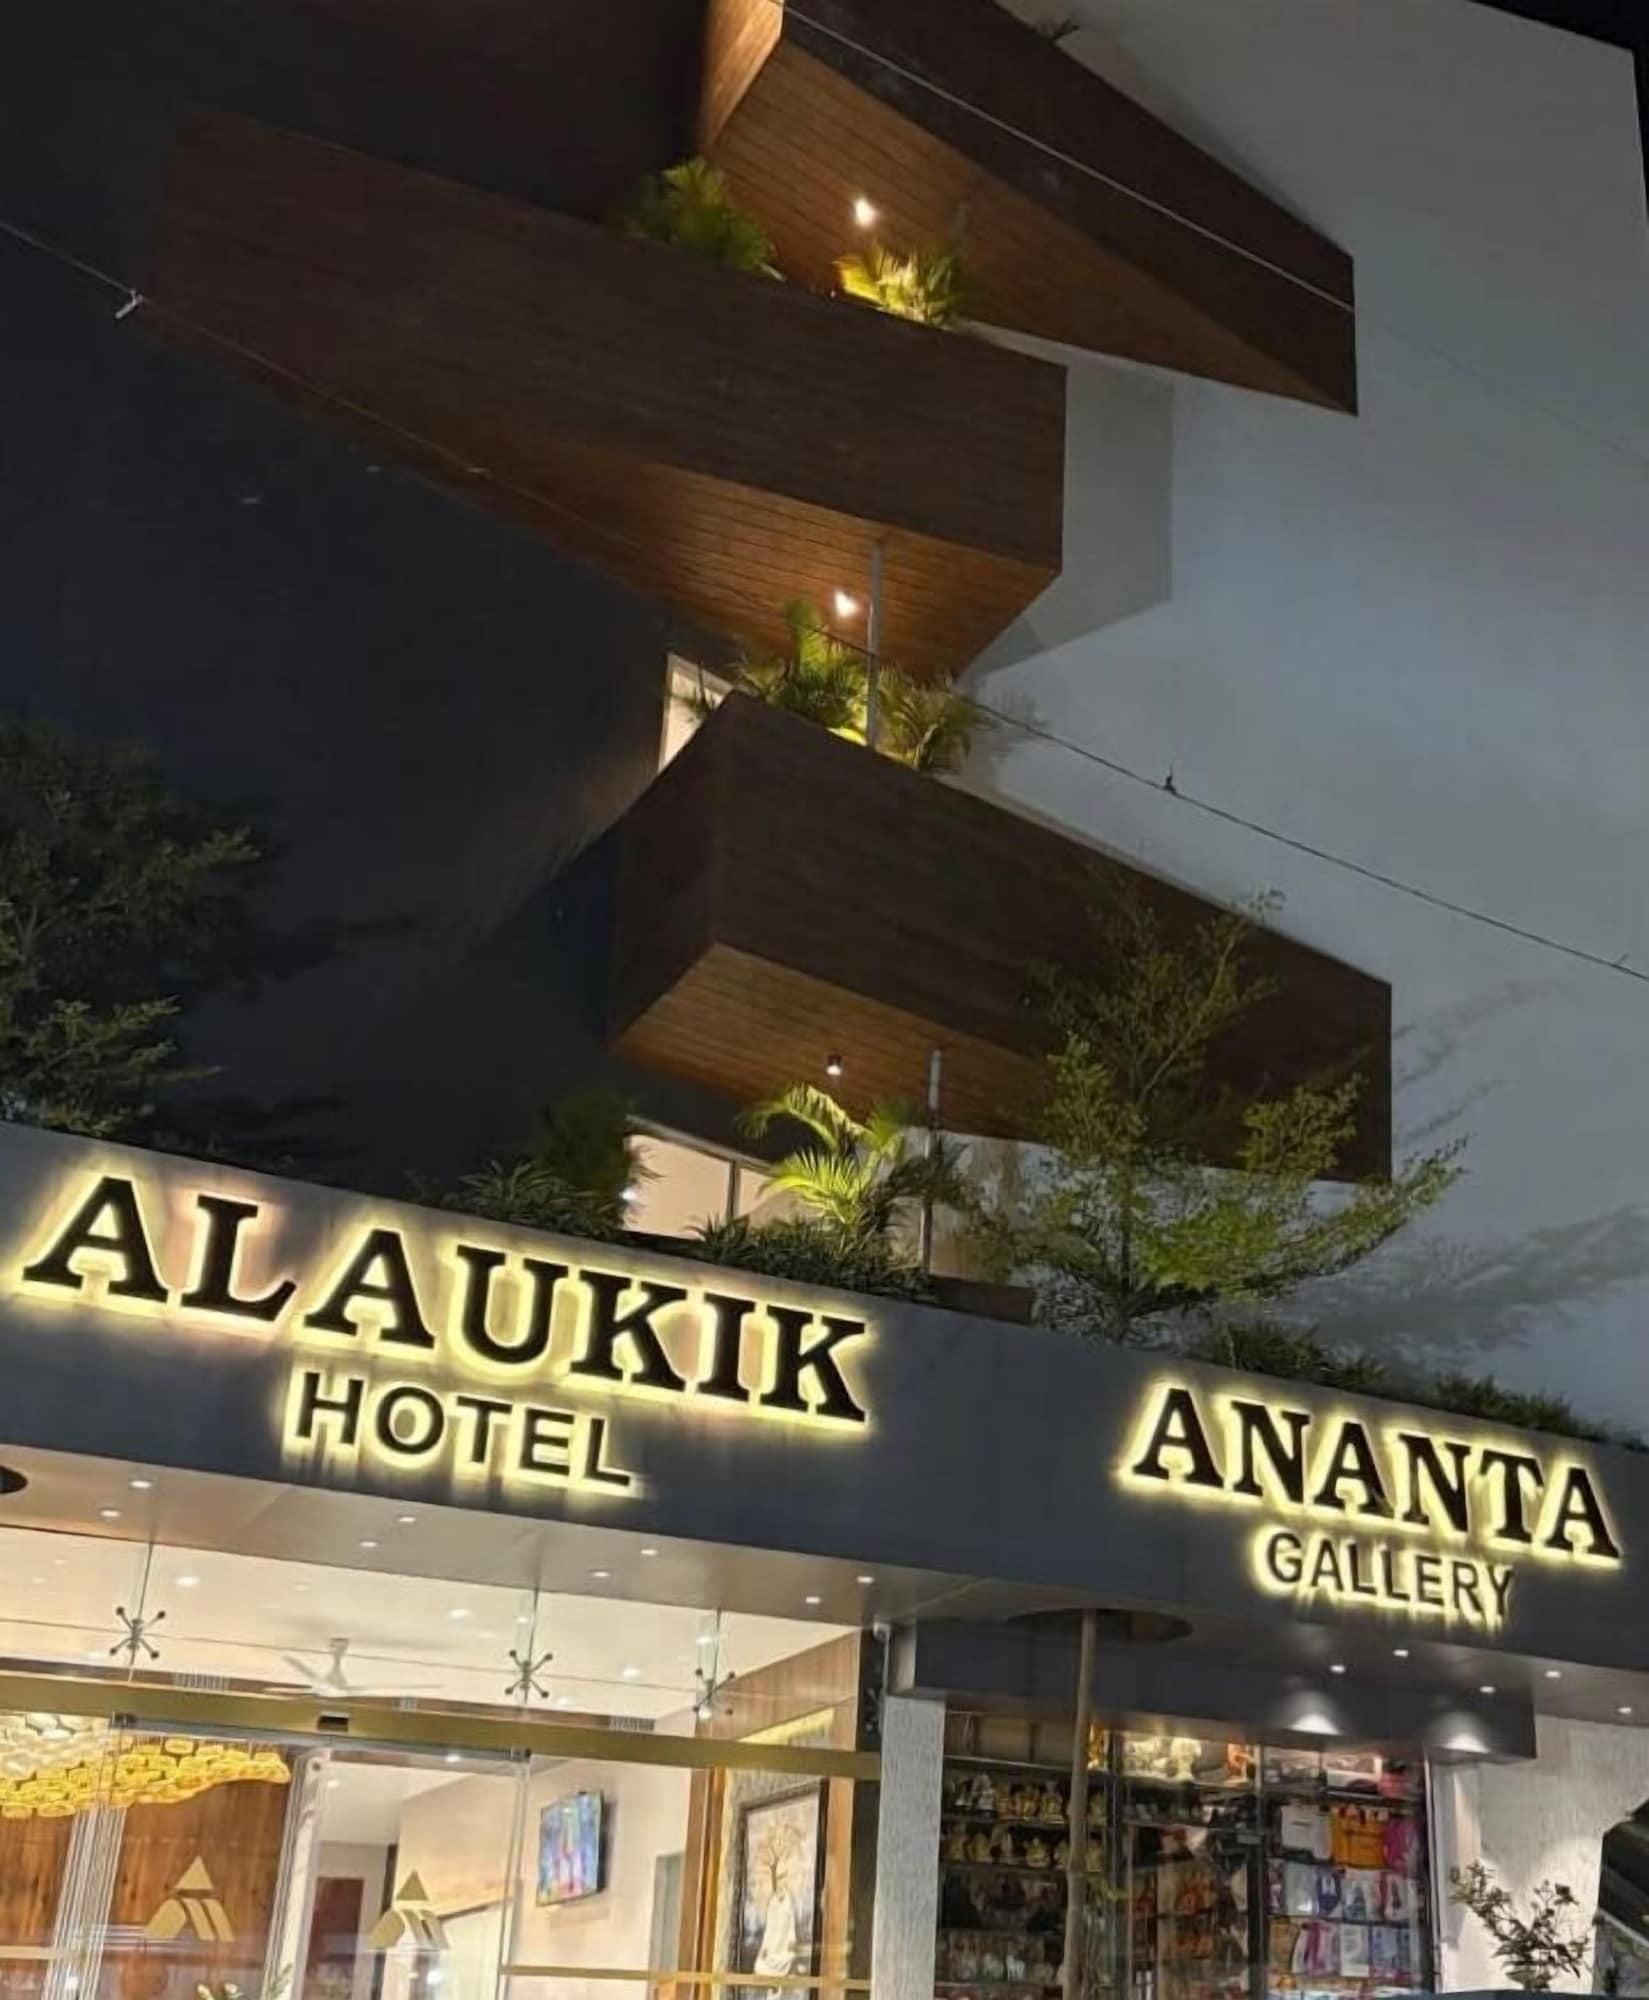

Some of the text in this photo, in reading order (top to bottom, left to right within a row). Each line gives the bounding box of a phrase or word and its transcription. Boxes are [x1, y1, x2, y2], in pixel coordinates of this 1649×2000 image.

[22, 1176, 867, 1424] ALAUKIK
[295, 1371, 632, 1488] HOTEL
[1132, 1387, 1621, 1558] ANANTA
[1266, 1531, 1514, 1616] GALLERY
